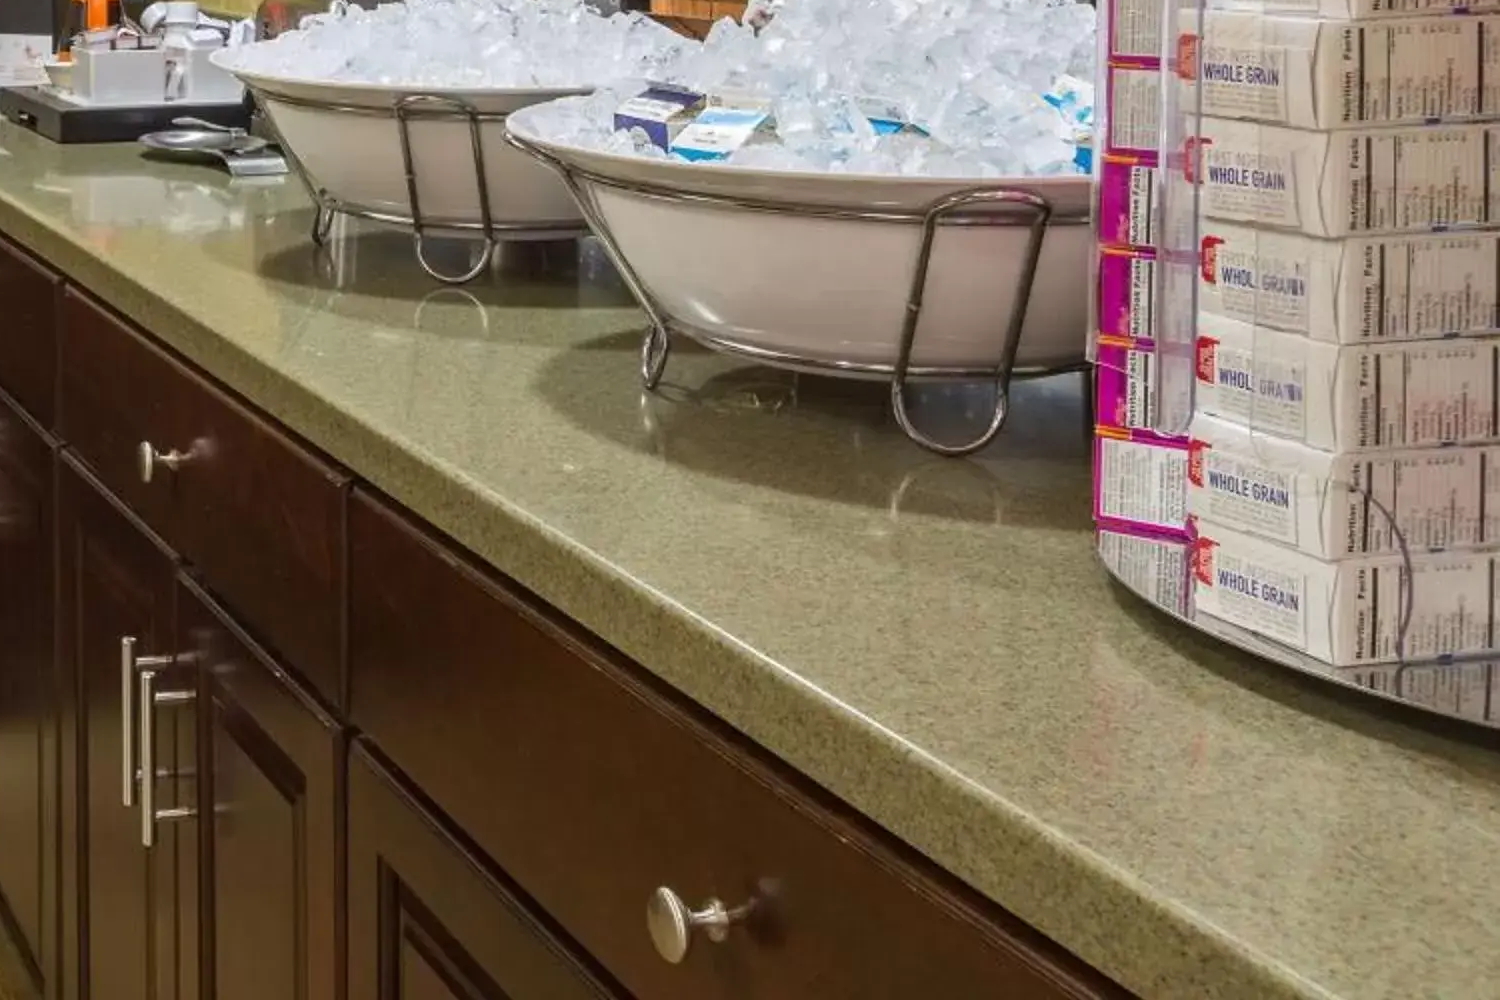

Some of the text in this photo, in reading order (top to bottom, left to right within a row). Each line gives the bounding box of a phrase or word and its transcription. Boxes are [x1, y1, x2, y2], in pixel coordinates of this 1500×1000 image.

[1342, 28, 1354, 61] Facts
[1203, 62, 1280, 87] WHOLE GRAIN
[1208, 166, 1286, 190] WHOLE GRAIN
[1208, 470, 1289, 509] WHOLE GRAIN
[1217, 567, 1259, 599] WHOLE
[1261, 583, 1300, 612] GRAIN
